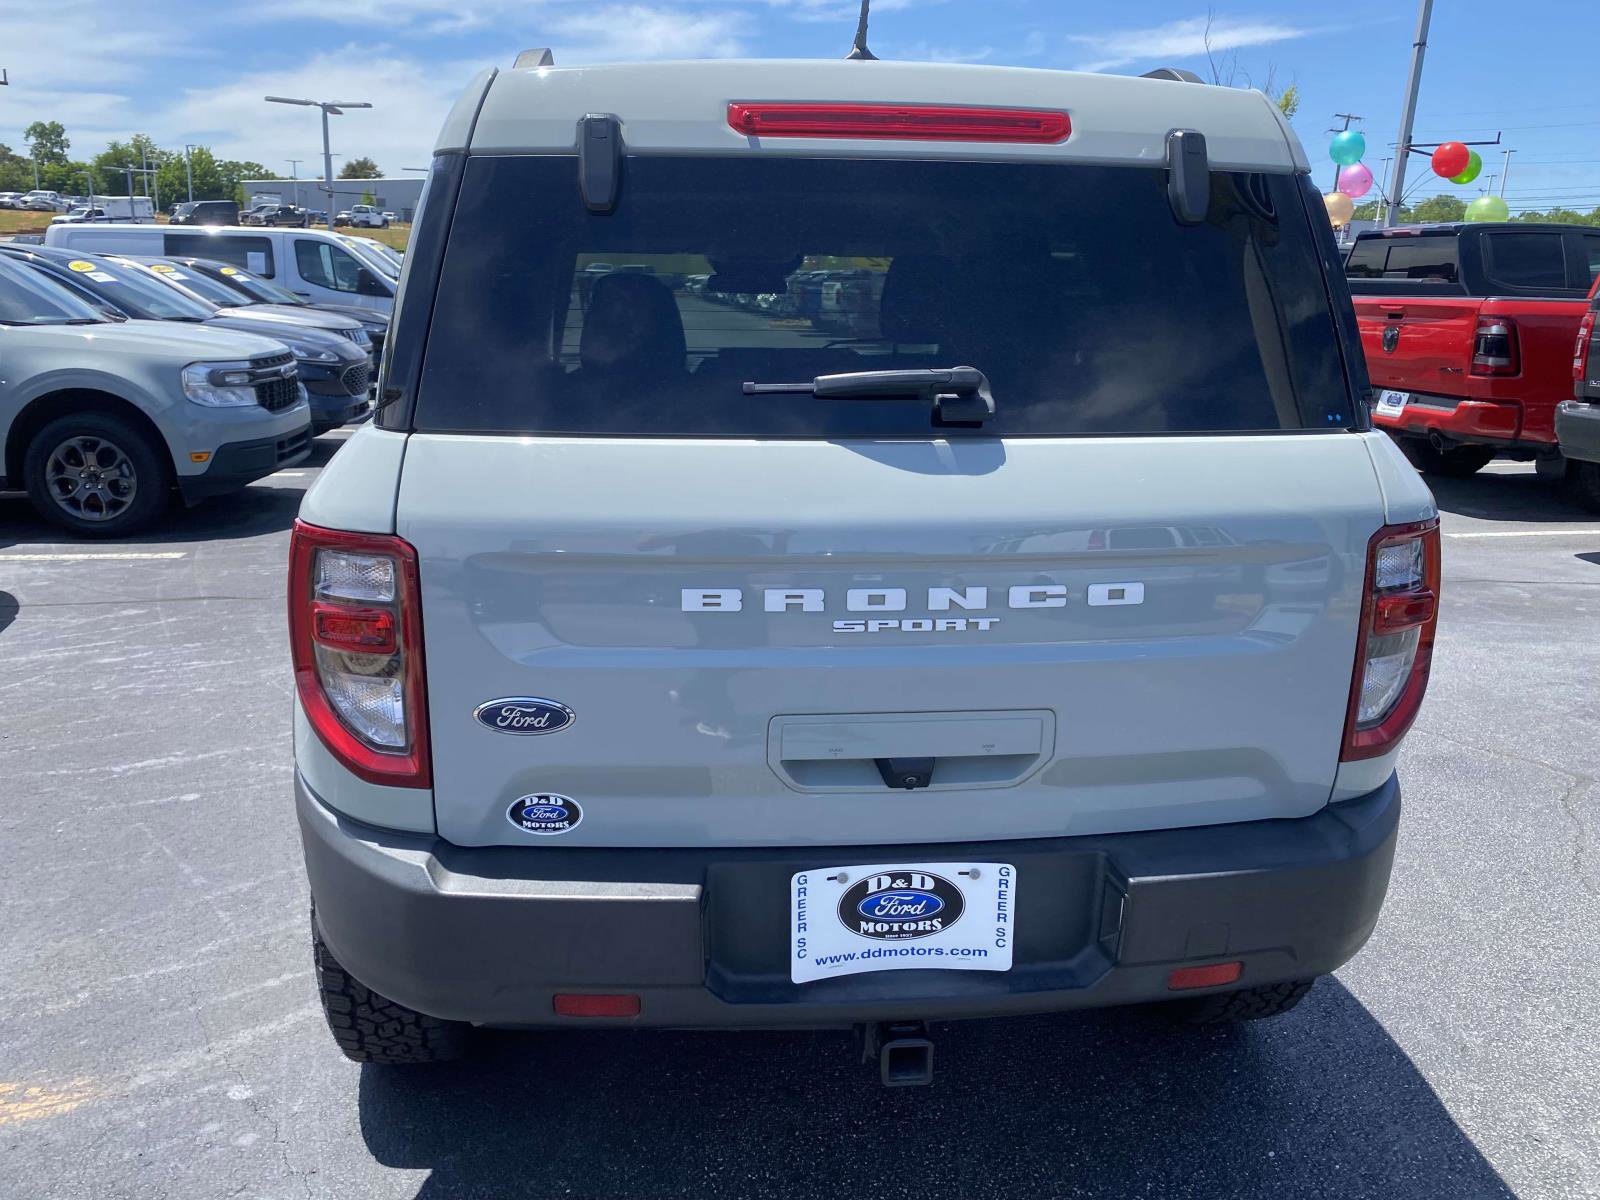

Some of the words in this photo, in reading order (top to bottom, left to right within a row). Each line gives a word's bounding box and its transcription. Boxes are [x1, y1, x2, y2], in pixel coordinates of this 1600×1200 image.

[681, 582, 1145, 612] BRONCO
[832, 618, 1000, 633] SPORT
[497, 705, 550, 728] Ford
[523, 796, 564, 807] D&D
[530, 808, 559, 819] Ford
[522, 820, 571, 829] MOTORS
[866, 873, 935, 894] D&D
[797, 874, 808, 933] GREER
[997, 866, 1010, 923] GREER
[875, 895, 926, 915] Ford
[860, 918, 943, 933] MOTORS
[995, 927, 1007, 948] SC
[797, 937, 808, 959] SC
[815, 947, 988, 966] www.ddmotors.com
